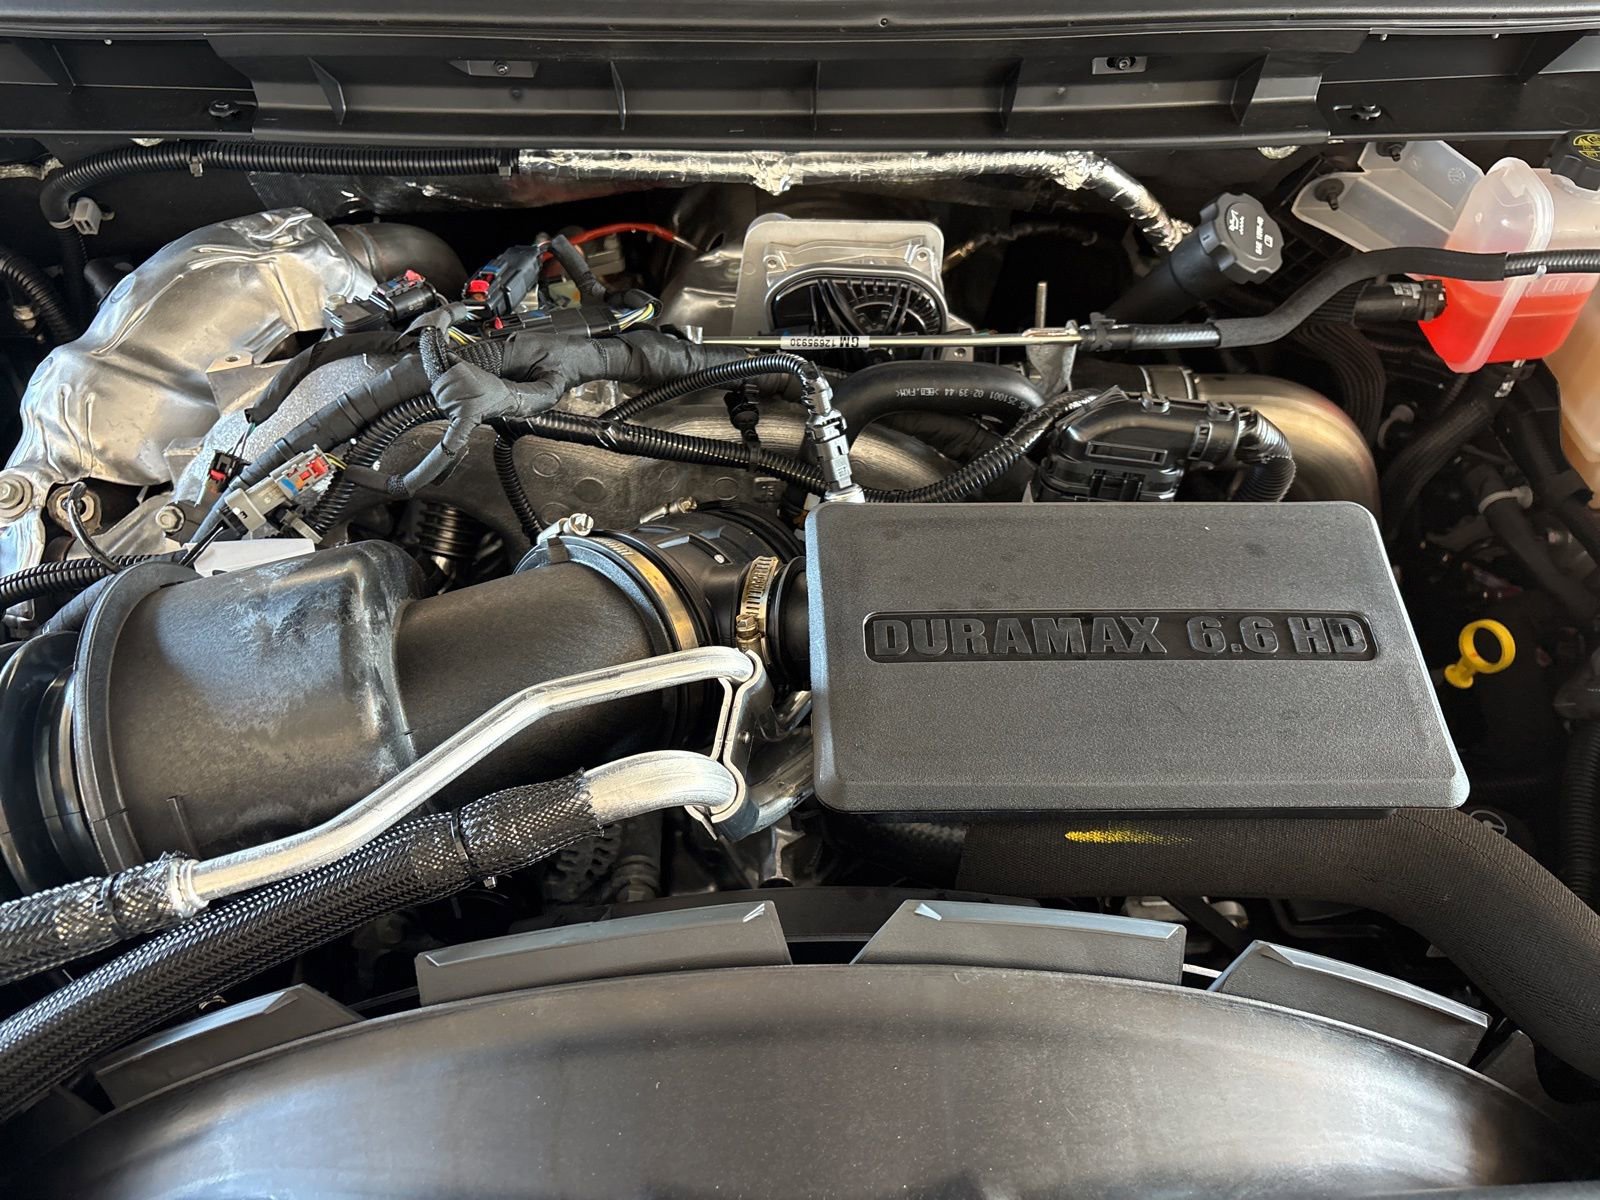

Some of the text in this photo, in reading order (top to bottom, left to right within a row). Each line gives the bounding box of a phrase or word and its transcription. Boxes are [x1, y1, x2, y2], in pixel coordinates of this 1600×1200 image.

[790, 336, 859, 348] GM 12695930
[873, 615, 1371, 657] DURAMAX 6.6 HD
